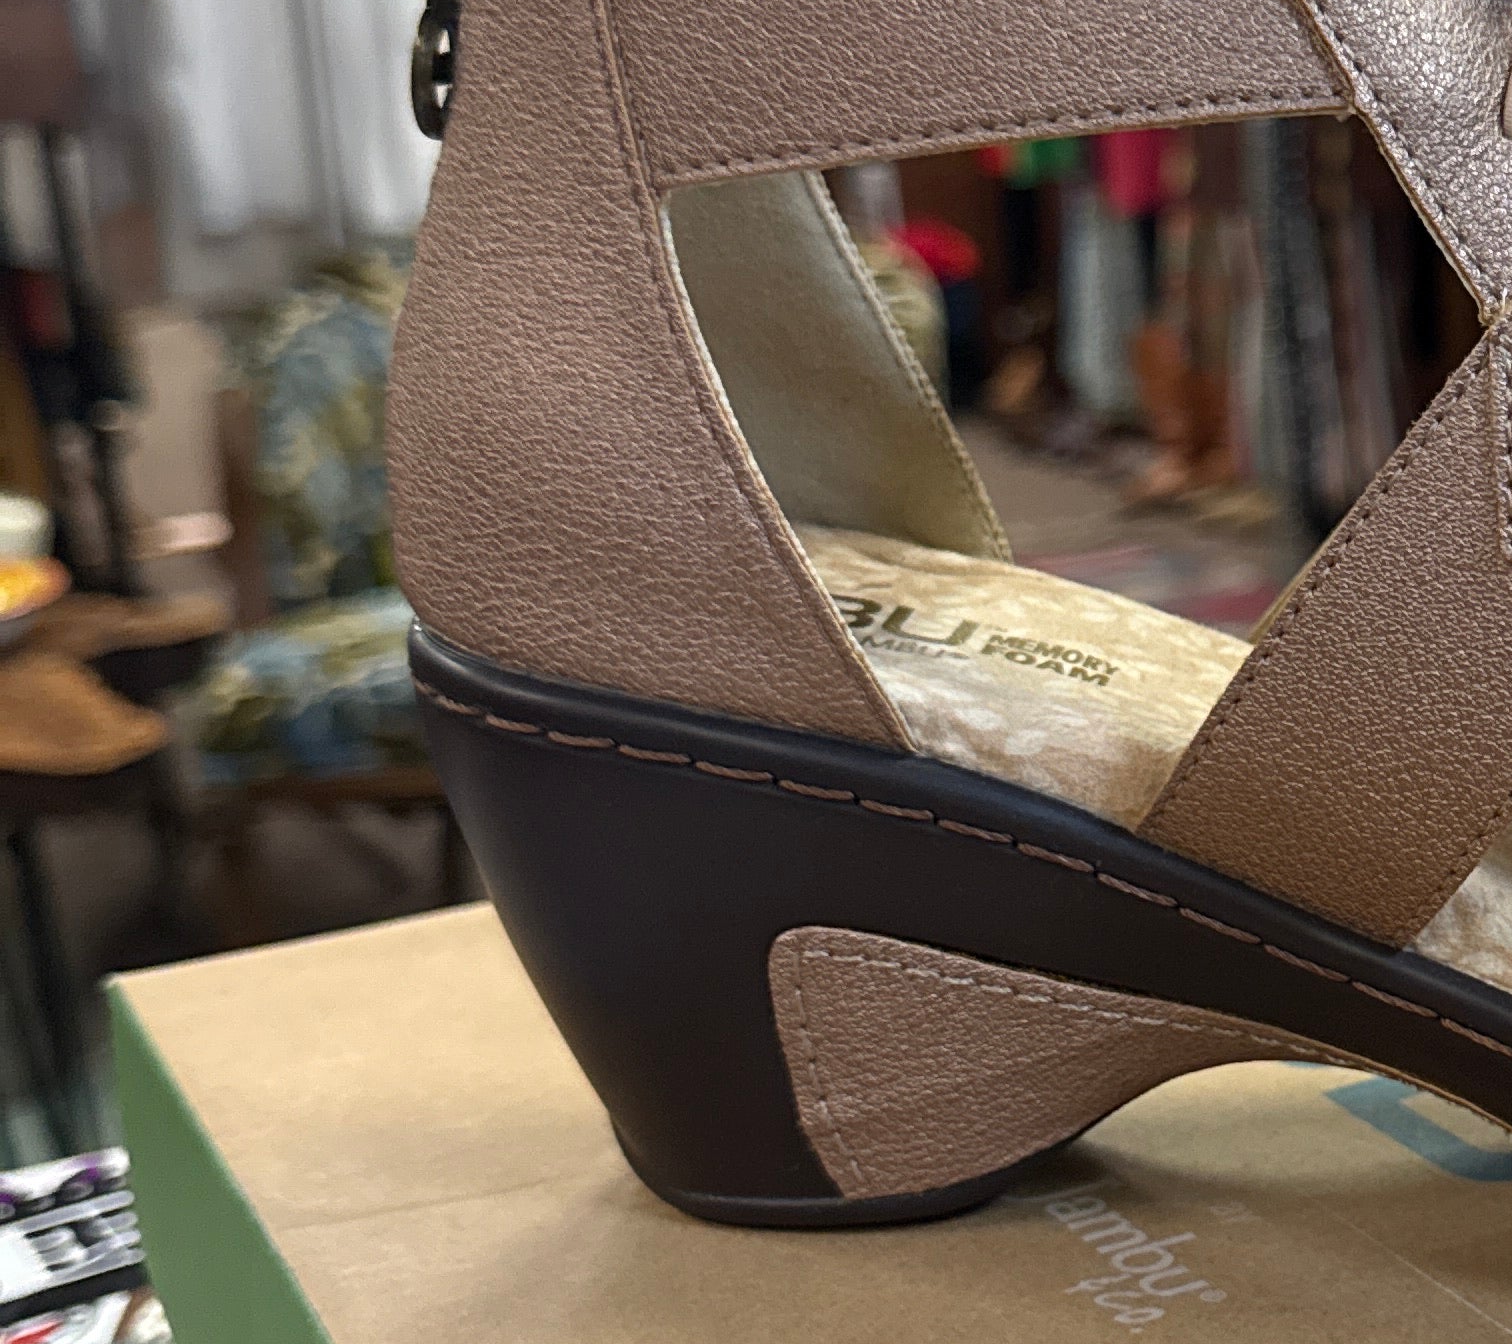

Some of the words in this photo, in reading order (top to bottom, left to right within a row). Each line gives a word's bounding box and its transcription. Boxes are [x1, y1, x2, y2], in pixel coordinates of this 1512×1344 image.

[830, 593, 981, 647] BU
[980, 643, 1110, 687] FOAM
[987, 634, 1121, 676] MEMORY
